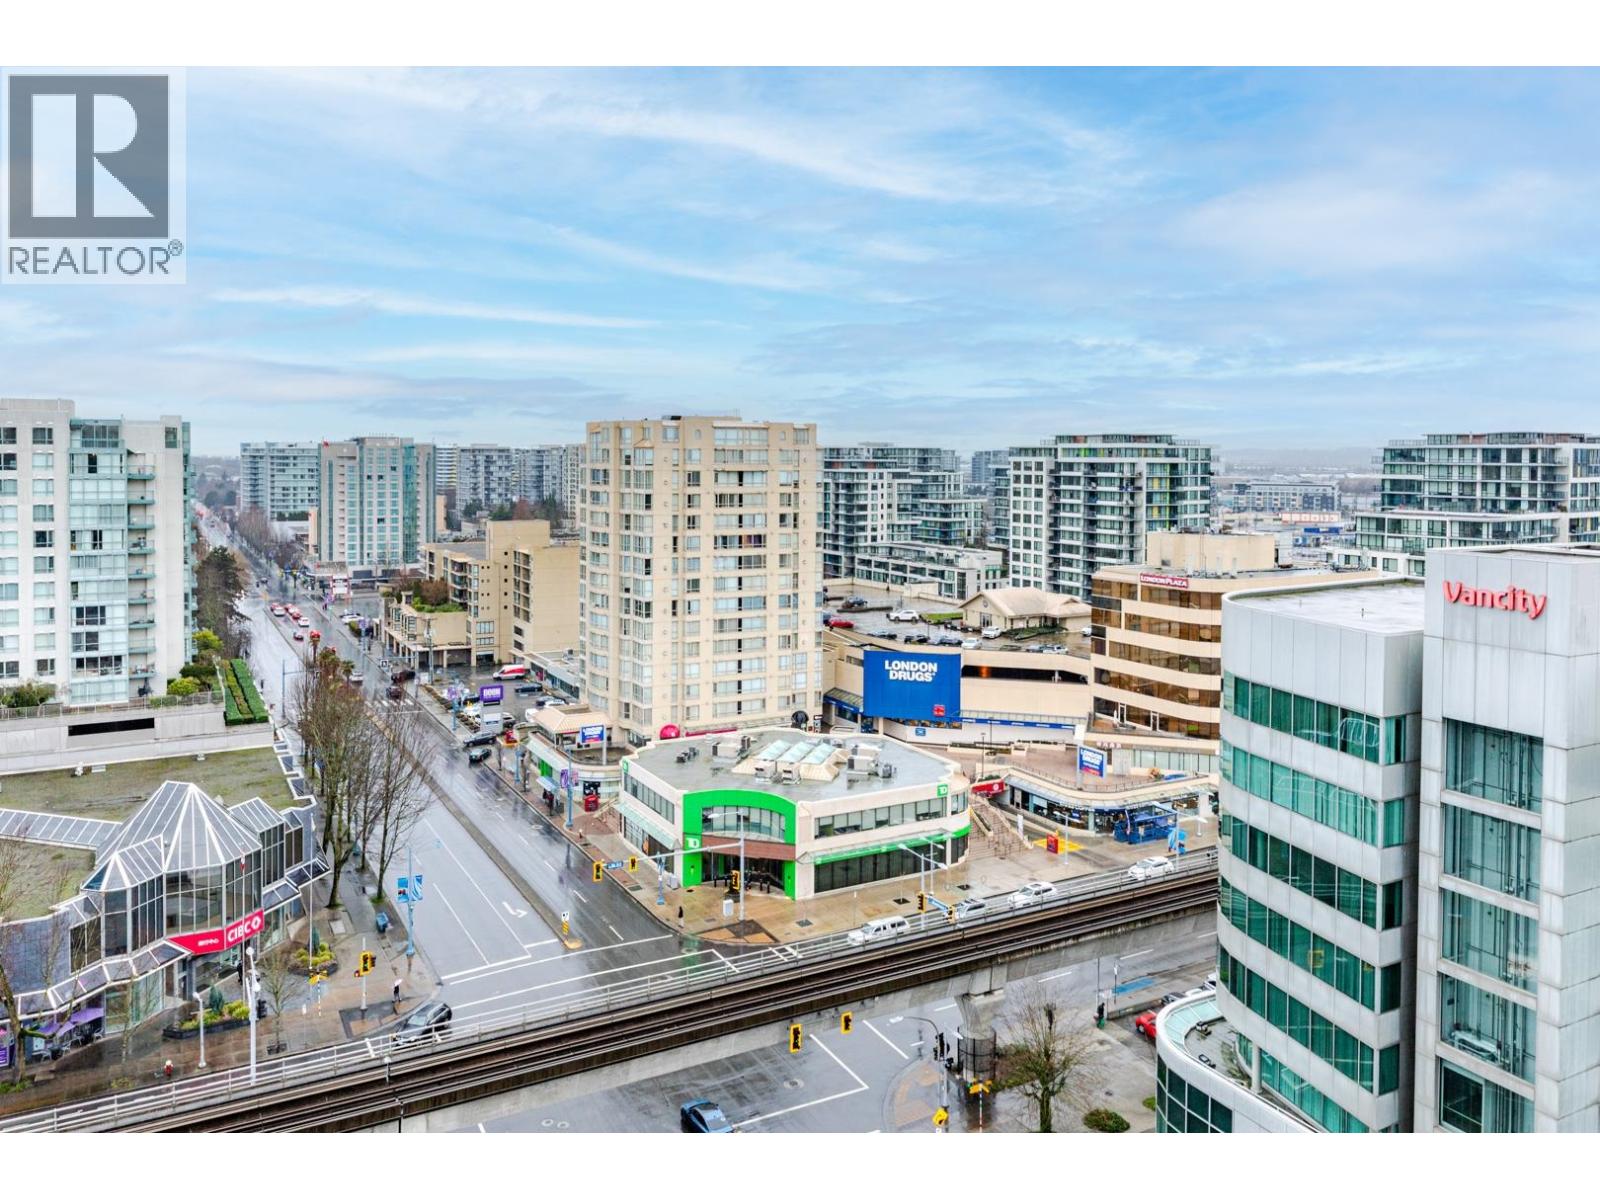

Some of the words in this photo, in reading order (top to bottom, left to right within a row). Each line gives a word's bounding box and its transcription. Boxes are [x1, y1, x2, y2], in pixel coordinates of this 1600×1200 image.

[1443, 580, 1547, 620] Vancity
[884, 660, 938, 673] LONDON
[686, 837, 700, 849] TD
